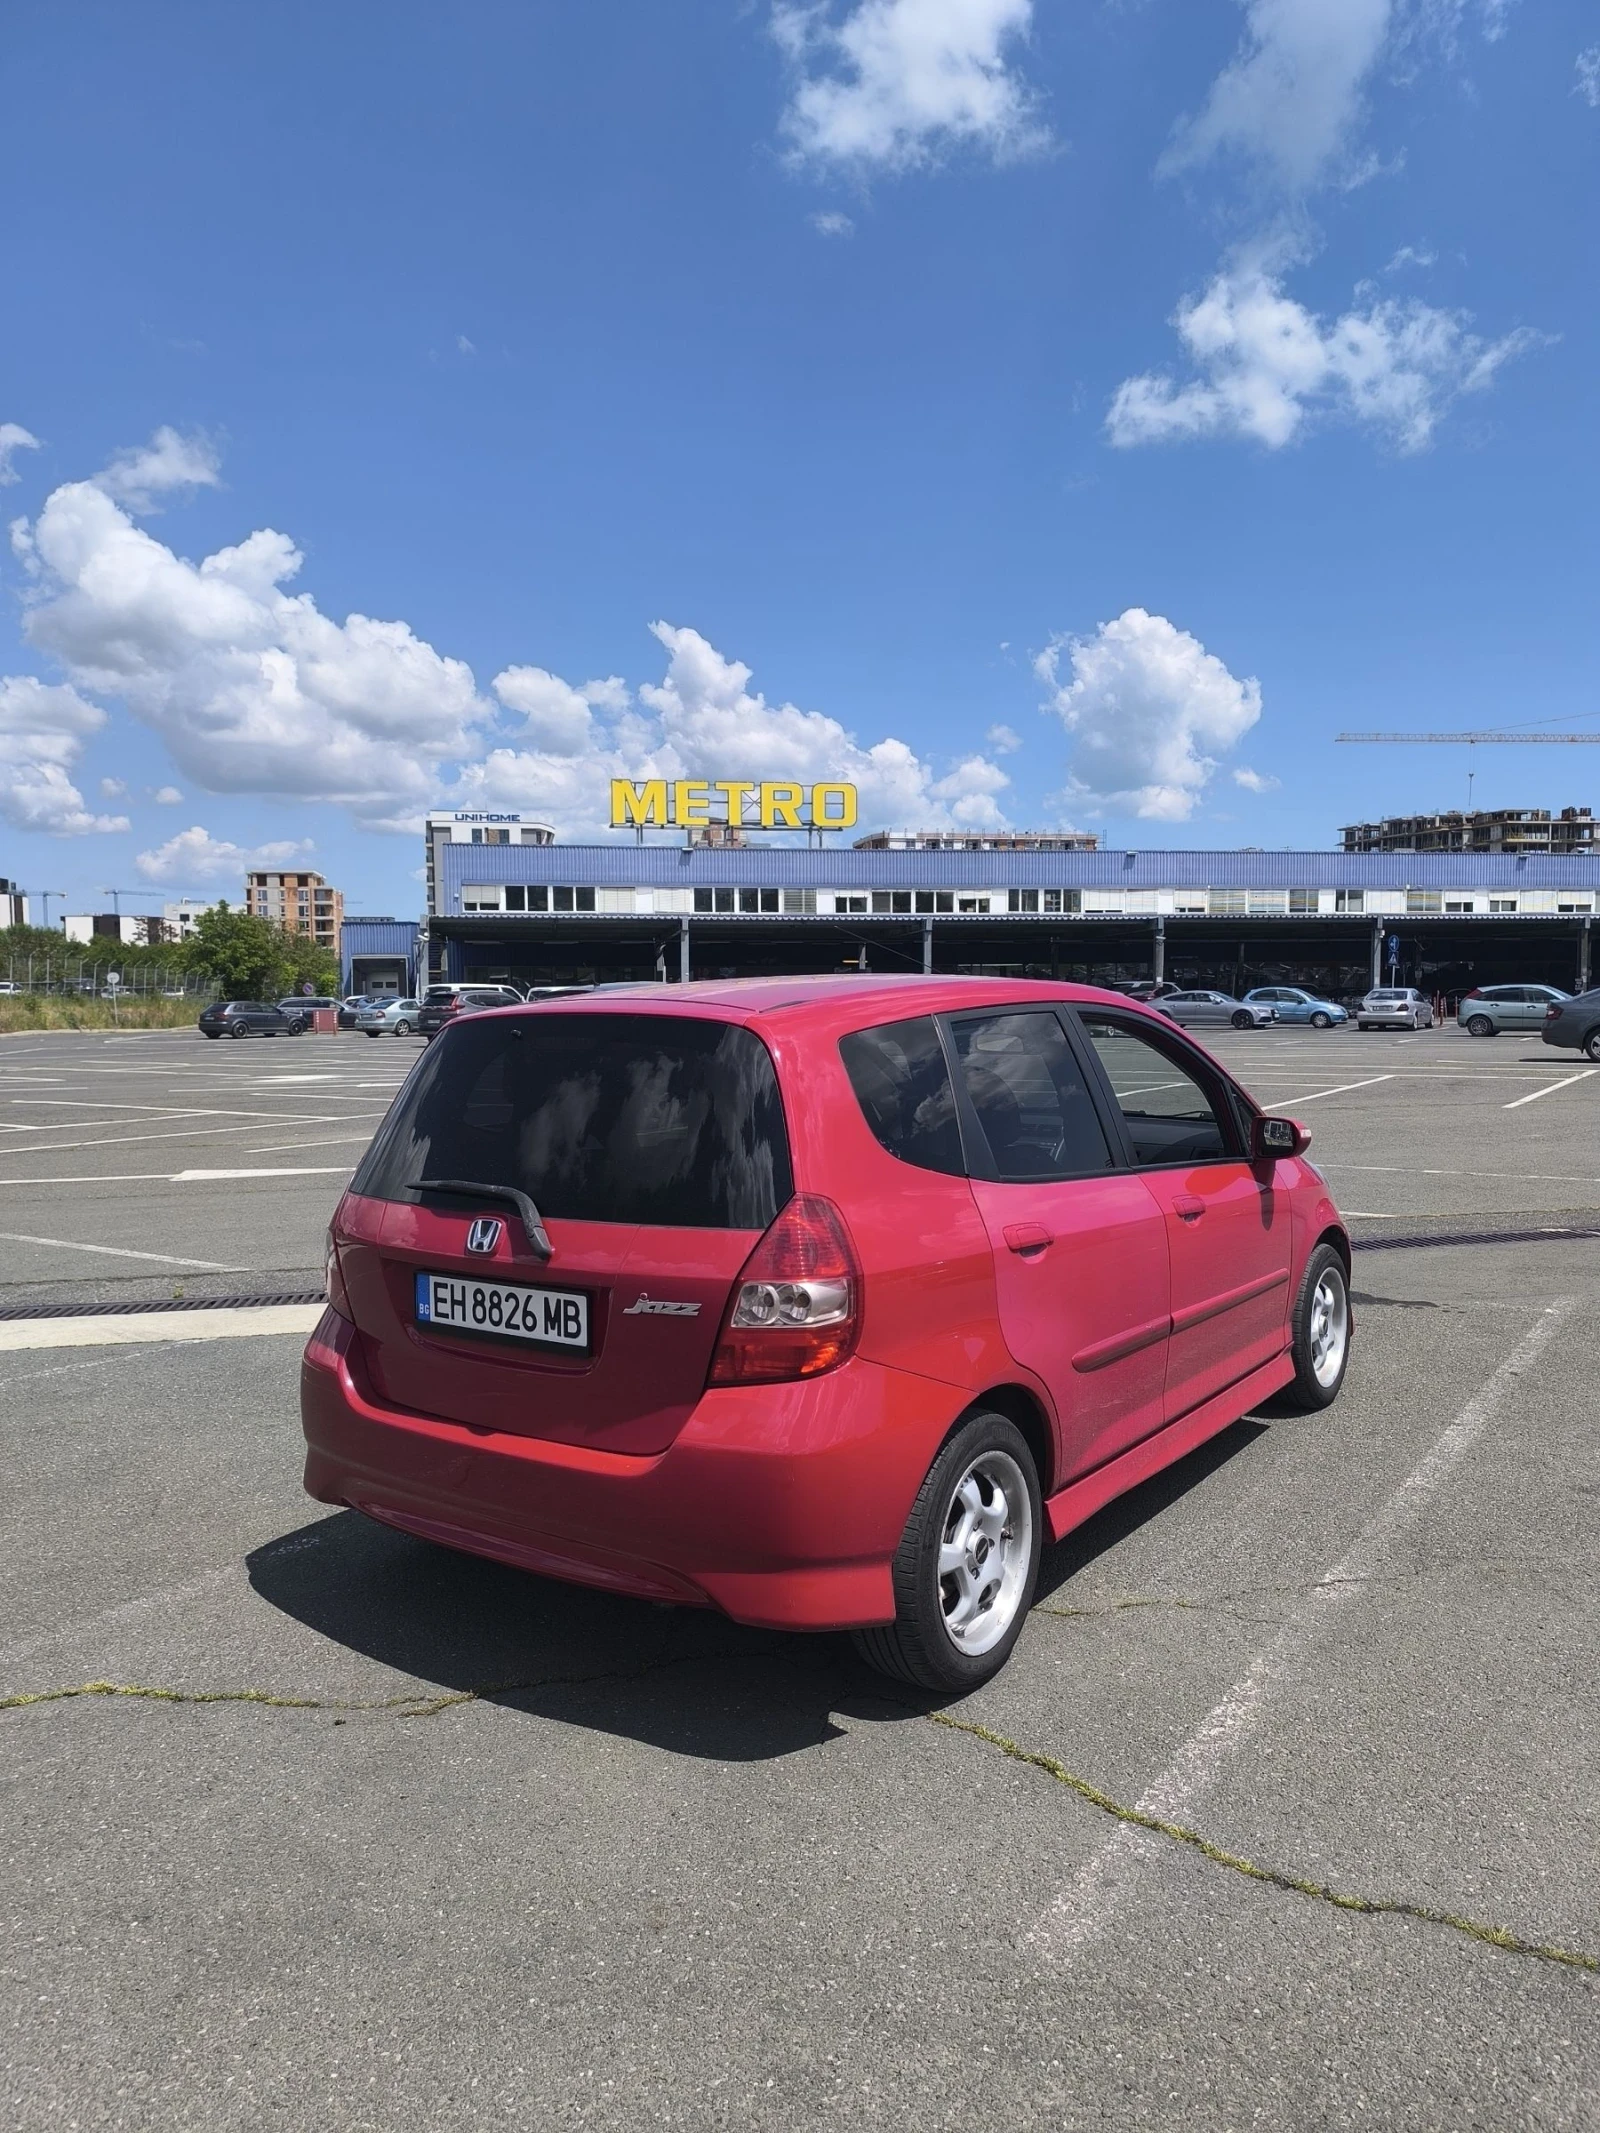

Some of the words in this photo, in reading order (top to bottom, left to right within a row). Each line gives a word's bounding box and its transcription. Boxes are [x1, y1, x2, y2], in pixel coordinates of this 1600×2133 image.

[611, 779, 857, 827] METRO
[455, 813, 521, 822] UNIHOME
[419, 1303, 430, 1315] BG
[433, 1281, 466, 1322] EH
[472, 1287, 537, 1332] 8826
[544, 1296, 582, 1339] MB
[622, 1292, 702, 1316] jazz
